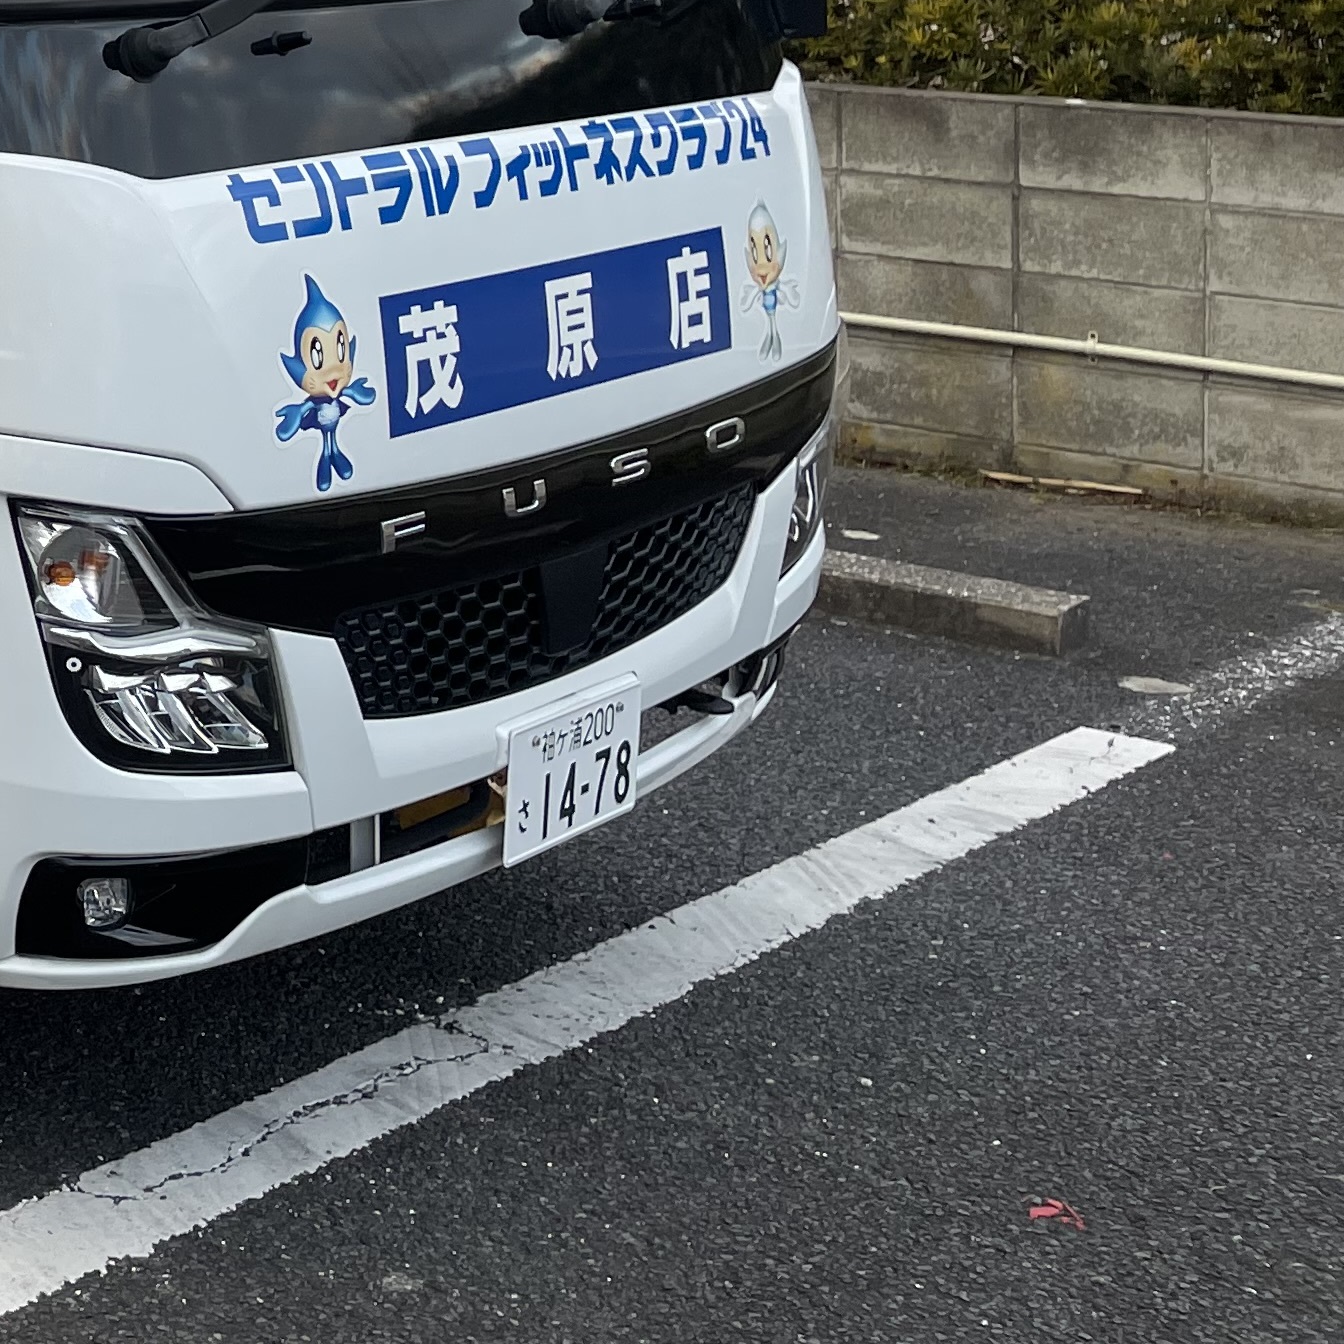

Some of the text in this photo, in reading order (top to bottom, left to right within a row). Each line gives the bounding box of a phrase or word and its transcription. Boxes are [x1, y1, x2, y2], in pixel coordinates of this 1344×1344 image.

[226, 97, 771, 245] セントラルフィットネスクラブ24
[397, 246, 712, 419] 茂原店
[380, 417, 746, 554] FUSO
[518, 739, 631, 840] さ 14-78
